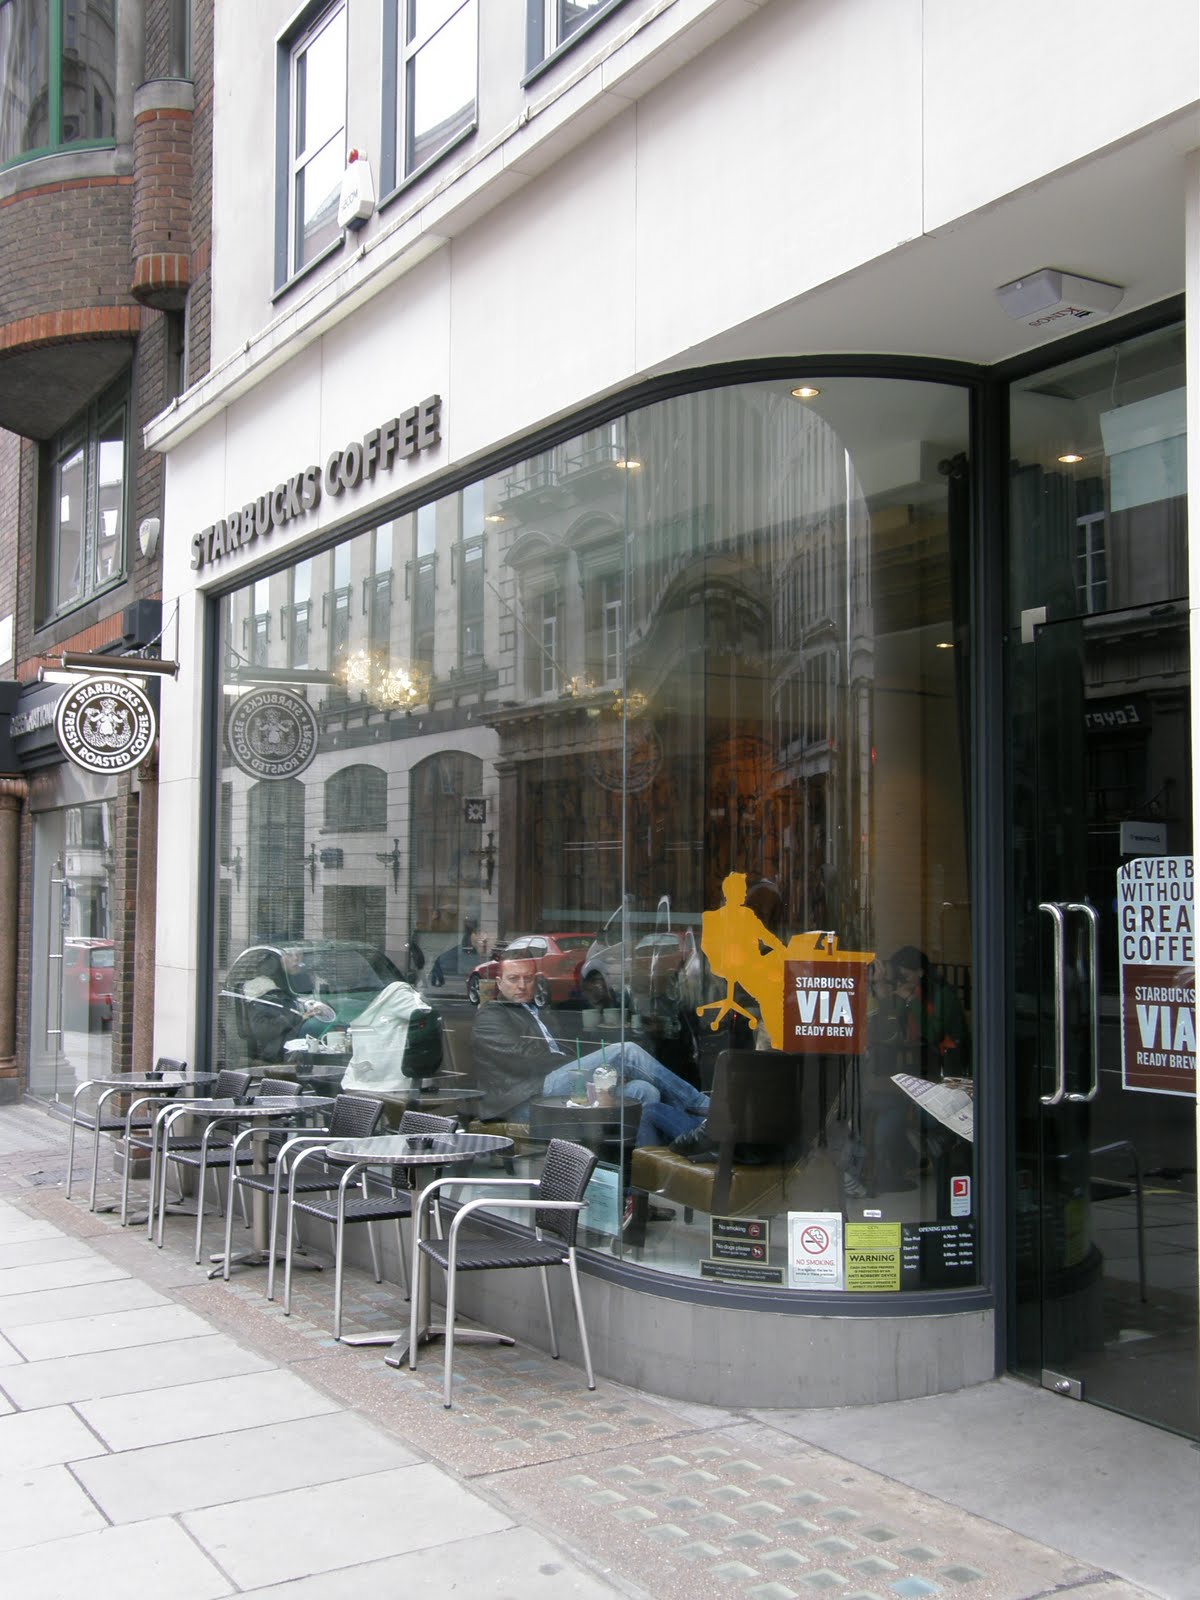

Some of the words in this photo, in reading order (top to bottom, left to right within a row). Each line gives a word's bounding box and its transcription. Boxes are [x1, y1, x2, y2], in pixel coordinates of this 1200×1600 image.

[191, 465, 322, 570] STARBUCKS
[325, 394, 442, 497] COFFEE
[75, 682, 141, 707] STARBUCKS
[64, 710, 82, 749] FRESH
[78, 747, 131, 767] ROASTED
[130, 714, 149, 755] COFFEE
[1121, 860, 1178, 880] NEVER
[1121, 881, 1194, 902] WITHOU
[1122, 905, 1194, 933] GREA
[1123, 935, 1194, 962] COFFE
[795, 976, 855, 989] STARBUCKS
[1135, 986, 1196, 1004] STARBUCKS
[796, 990, 854, 1025] VIA
[795, 1025, 825, 1037] READY
[826, 1026, 854, 1037] BREW
[1136, 1004, 1197, 1052] VIA
[1136, 1051, 1168, 1068] READY
[1169, 1054, 1197, 1070] BREW
[849, 1254, 895, 1262] WARNING
